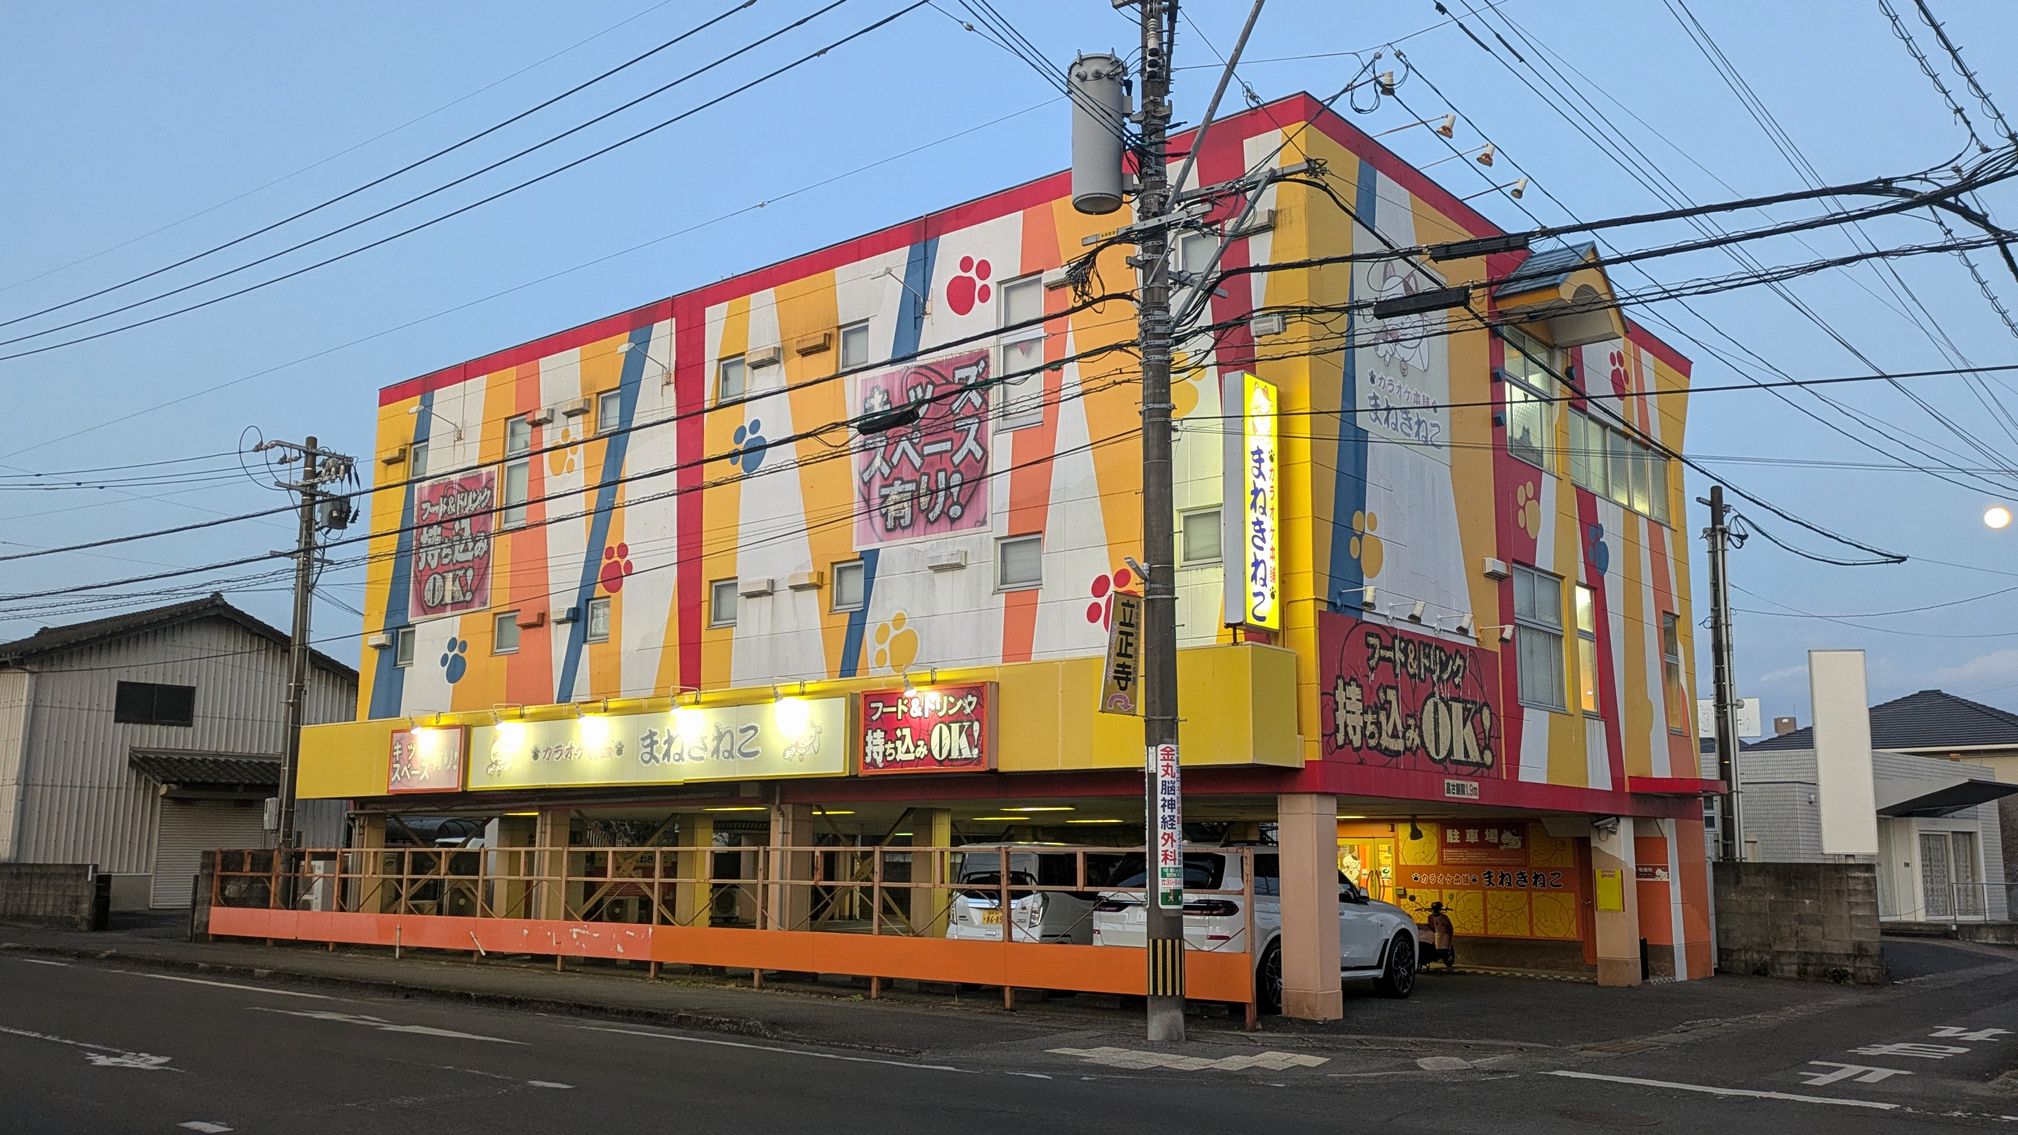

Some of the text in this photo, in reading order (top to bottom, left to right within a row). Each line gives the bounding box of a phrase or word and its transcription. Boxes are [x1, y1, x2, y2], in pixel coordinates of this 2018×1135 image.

[1367, 390, 1442, 449] まねきねこ
[861, 416, 985, 483] スペース
[878, 469, 965, 531] 有り!
[1250, 445, 1267, 622] まねきねこ
[423, 566, 475, 608] OK!
[1113, 599, 1136, 692] 立正寺
[1365, 632, 1467, 688] フード&ドリンク
[869, 693, 978, 721] フード&ドリンク
[391, 761, 429, 783] スペース
[1160, 746, 1176, 866] 金丸脳神経外科
[1446, 829, 1499, 844] 駐車場
[1481, 870, 1564, 888] まねきねこ
